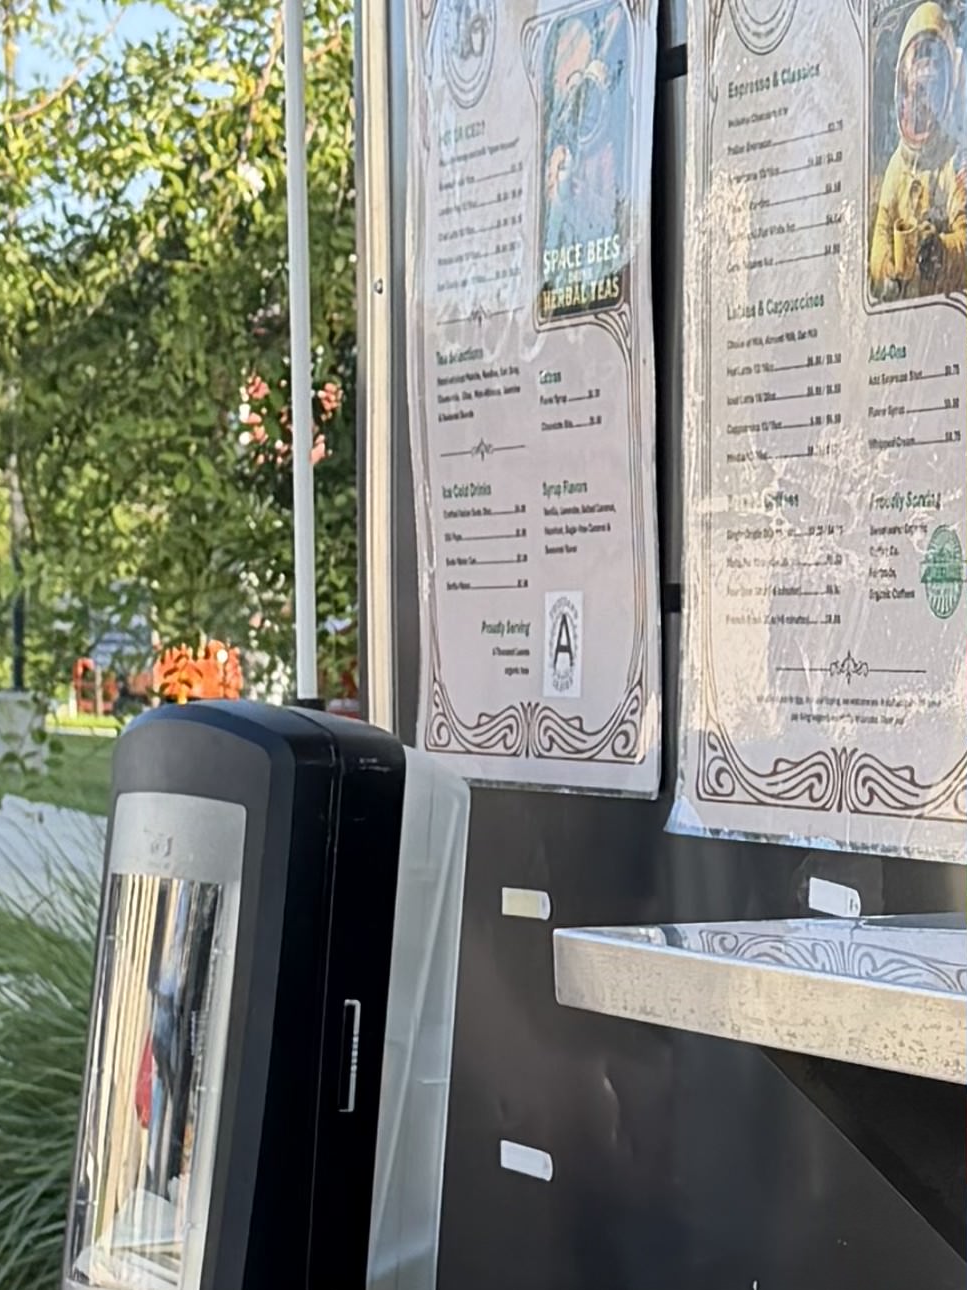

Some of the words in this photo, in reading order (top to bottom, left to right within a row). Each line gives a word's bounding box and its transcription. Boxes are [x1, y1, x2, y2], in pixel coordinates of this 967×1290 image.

[728, 76, 771, 100] Espresso
[772, 70, 780, 88] &
[781, 62, 821, 86] Classics
[543, 242, 583, 276] SPACE
[587, 234, 620, 264] BEES
[541, 281, 589, 312] HERBAL
[589, 276, 620, 301] TEAS
[757, 299, 765, 317] &
[766, 293, 825, 318] Cappuccinos
[869, 344, 906, 363] Add-Ons
[453, 483, 469, 499] Cold
[470, 482, 492, 498] Drinks
[542, 481, 561, 500] Syrup
[481, 620, 505, 638] Proudly
[506, 619, 531, 638] Serving
